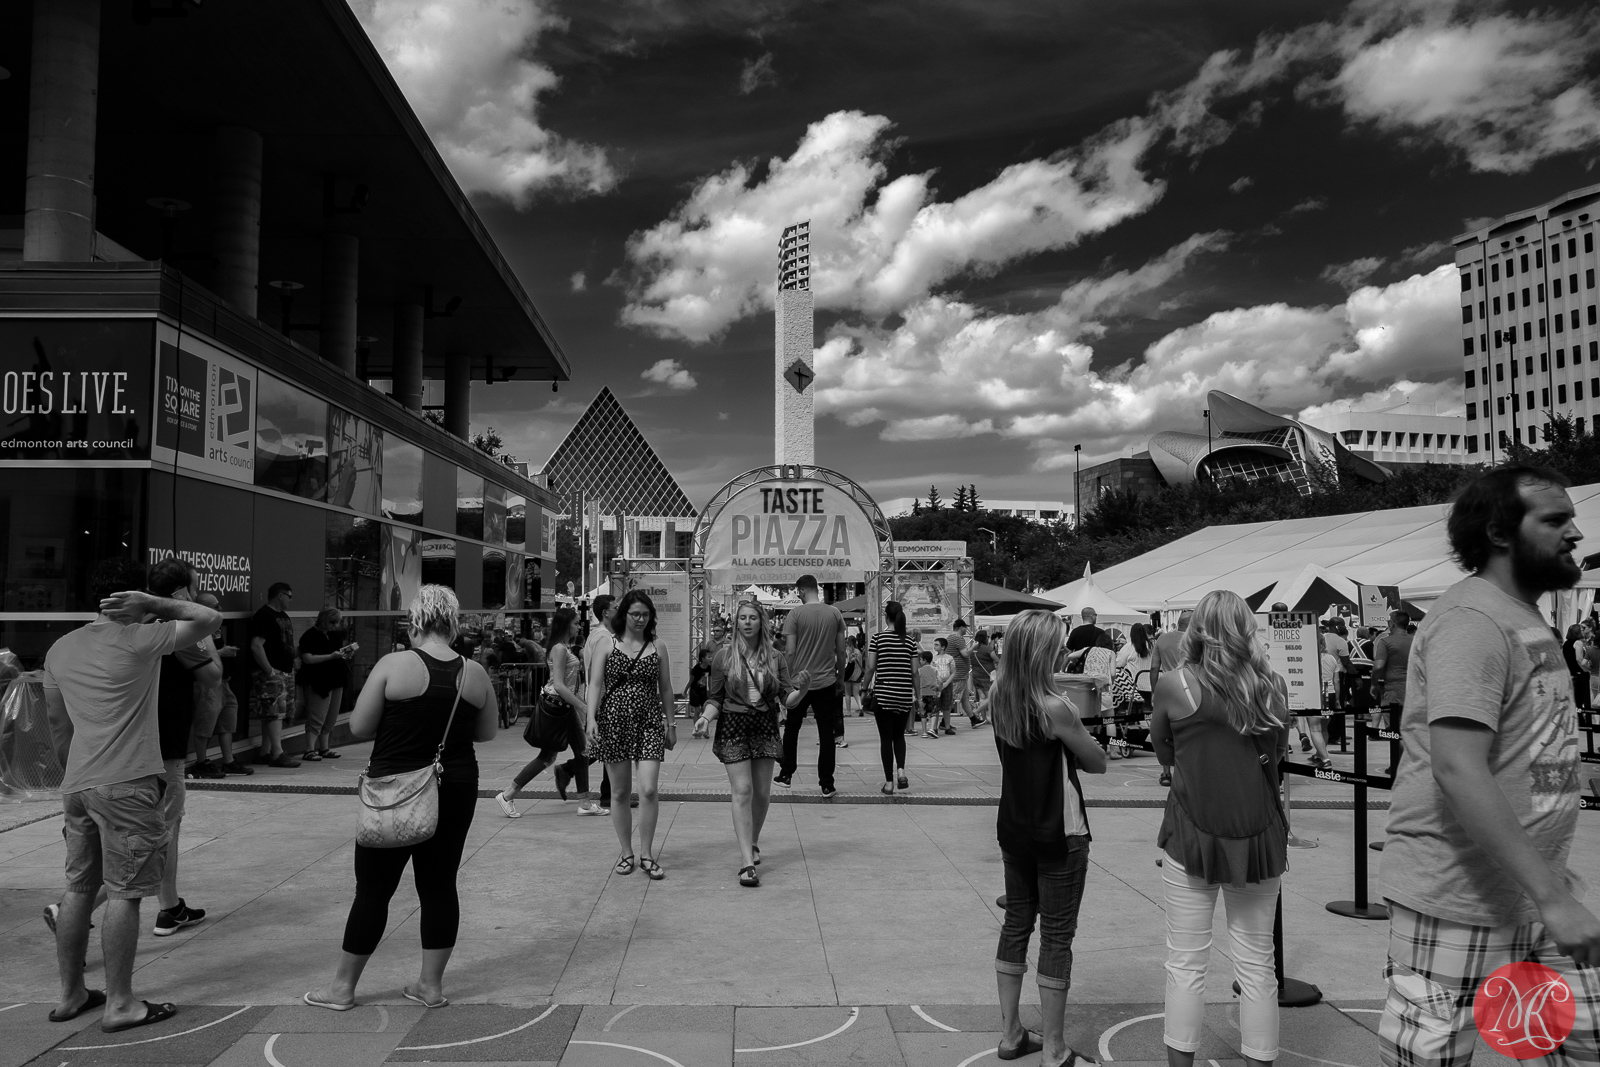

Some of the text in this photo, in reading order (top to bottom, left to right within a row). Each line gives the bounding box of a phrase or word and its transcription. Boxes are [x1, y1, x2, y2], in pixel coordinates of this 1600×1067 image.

[4, 371, 135, 415] OES LIVE.
[209, 364, 217, 439] edmonton
[1, 438, 134, 449] edmonton arts council
[209, 447, 254, 470] arts council
[760, 488, 824, 514] TASTE
[731, 515, 851, 556] PIAZZA
[898, 545, 942, 553] EDMONTON
[731, 558, 851, 567] ALL AGES LICENSED AREA
[1272, 619, 1303, 629] ticket
[1273, 629, 1300, 640] PRICES
[1378, 729, 1400, 739] taste
[1109, 737, 1127, 747] taste
[1314, 768, 1341, 781] taste
